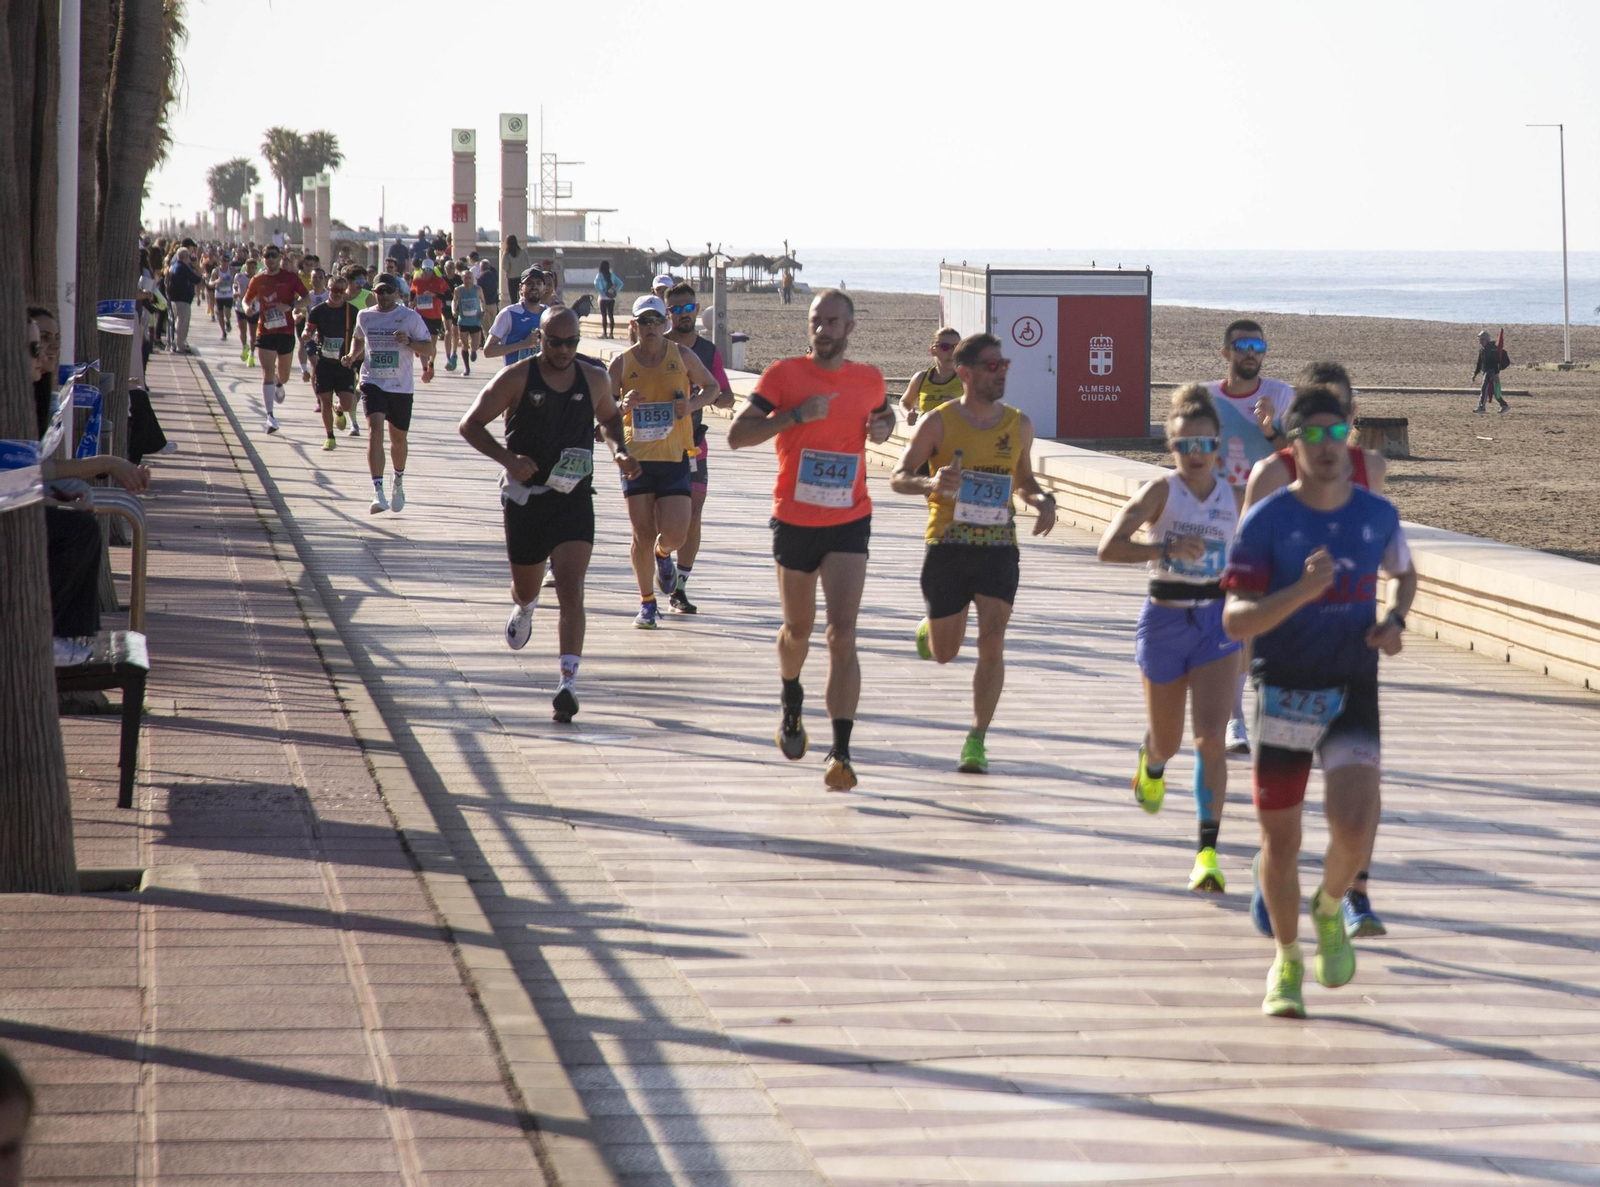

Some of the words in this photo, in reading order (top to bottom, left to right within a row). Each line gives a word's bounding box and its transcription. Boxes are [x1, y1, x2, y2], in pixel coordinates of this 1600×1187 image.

[374, 355, 393, 364] 460
[636, 410, 670, 422] 1859
[813, 462, 848, 479] 544
[973, 482, 1003, 499] 739
[1278, 688, 1327, 715] 275
